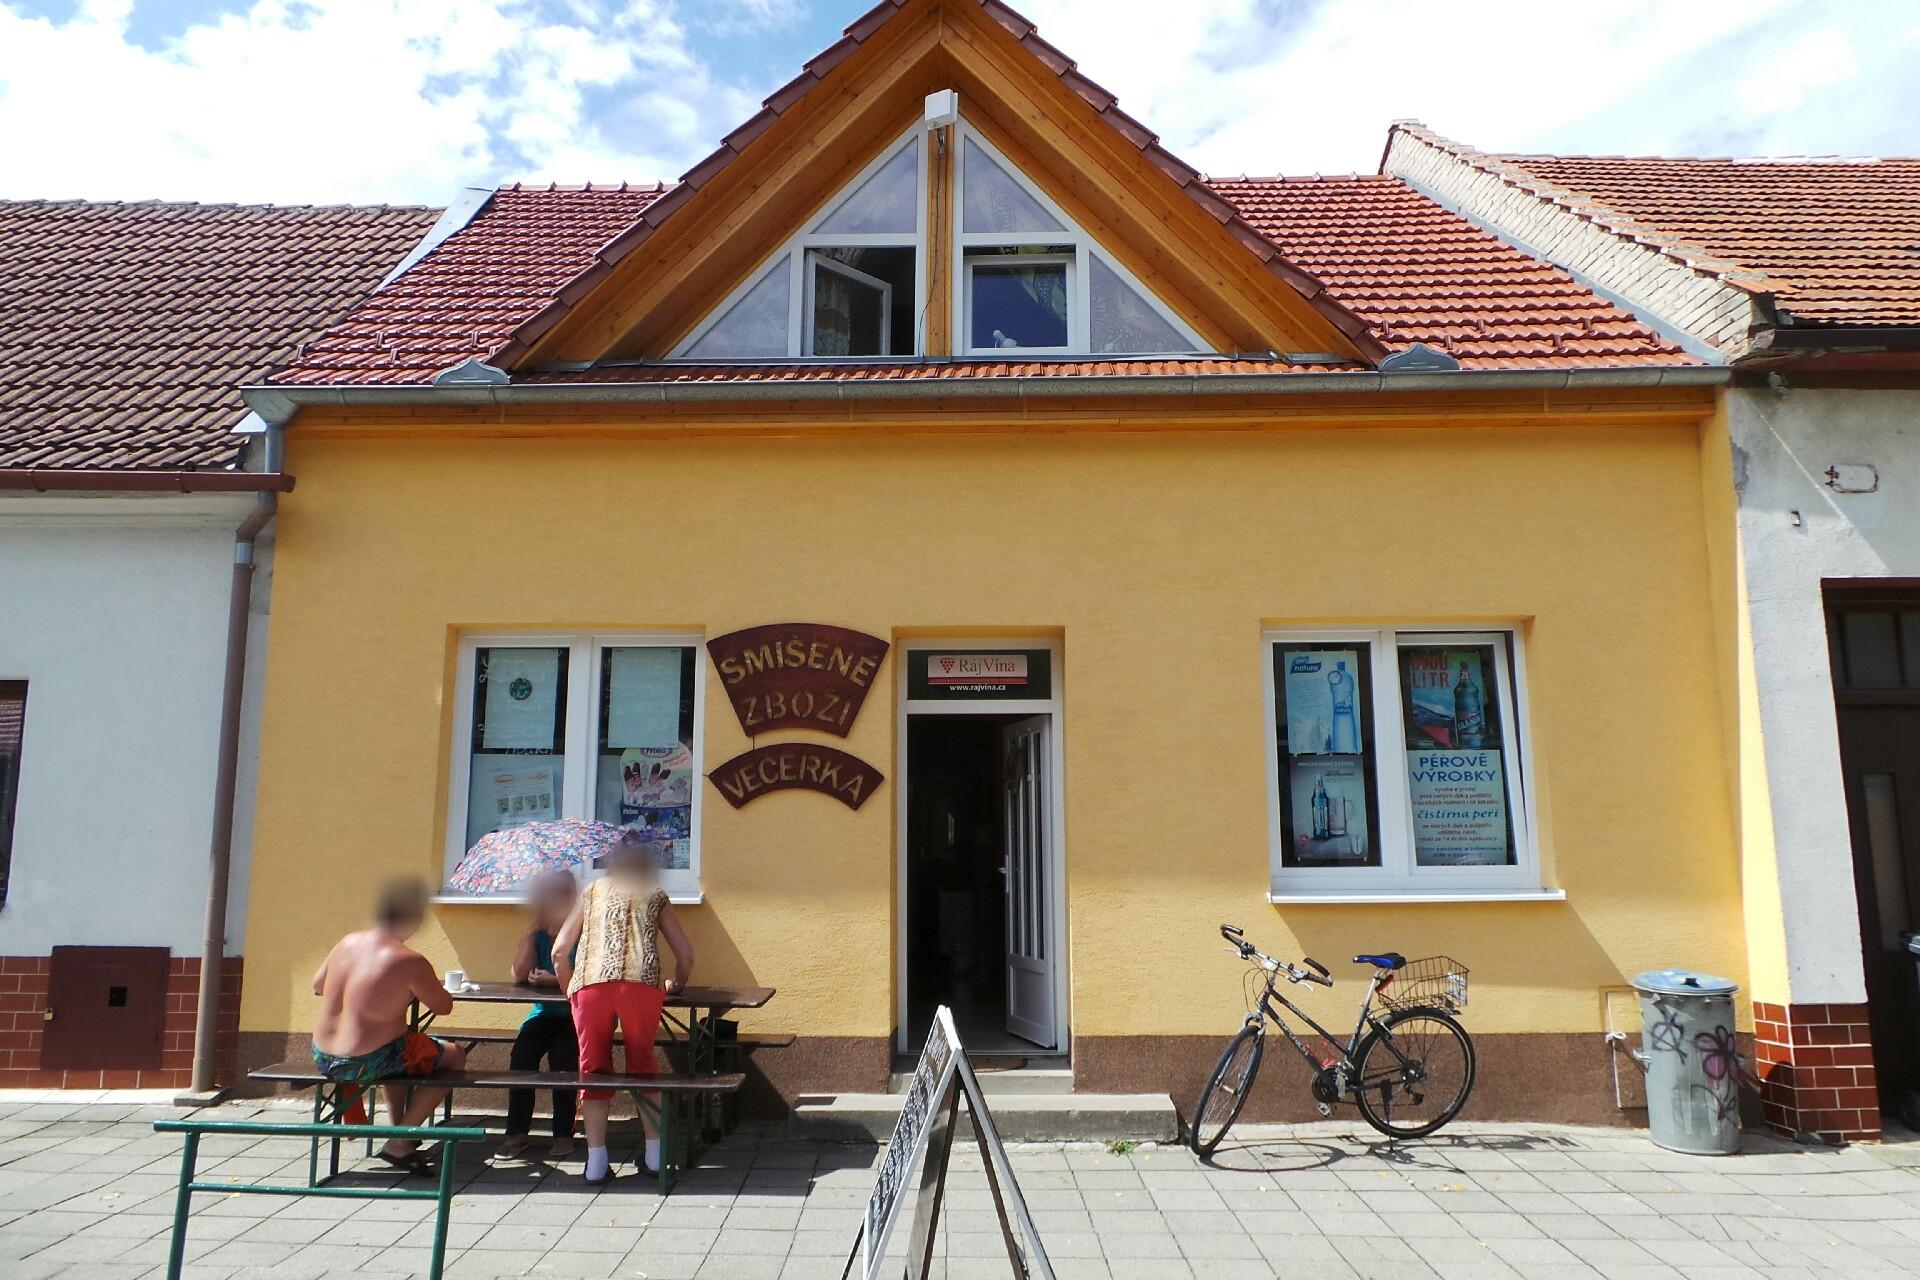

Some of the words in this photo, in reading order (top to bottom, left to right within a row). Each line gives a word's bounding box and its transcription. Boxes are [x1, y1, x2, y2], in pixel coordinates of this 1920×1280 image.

[1411, 672, 1449, 688] LITR
[1419, 753, 1488, 767] PÉROVÉ
[1412, 768, 1496, 782] VÝROBKY
